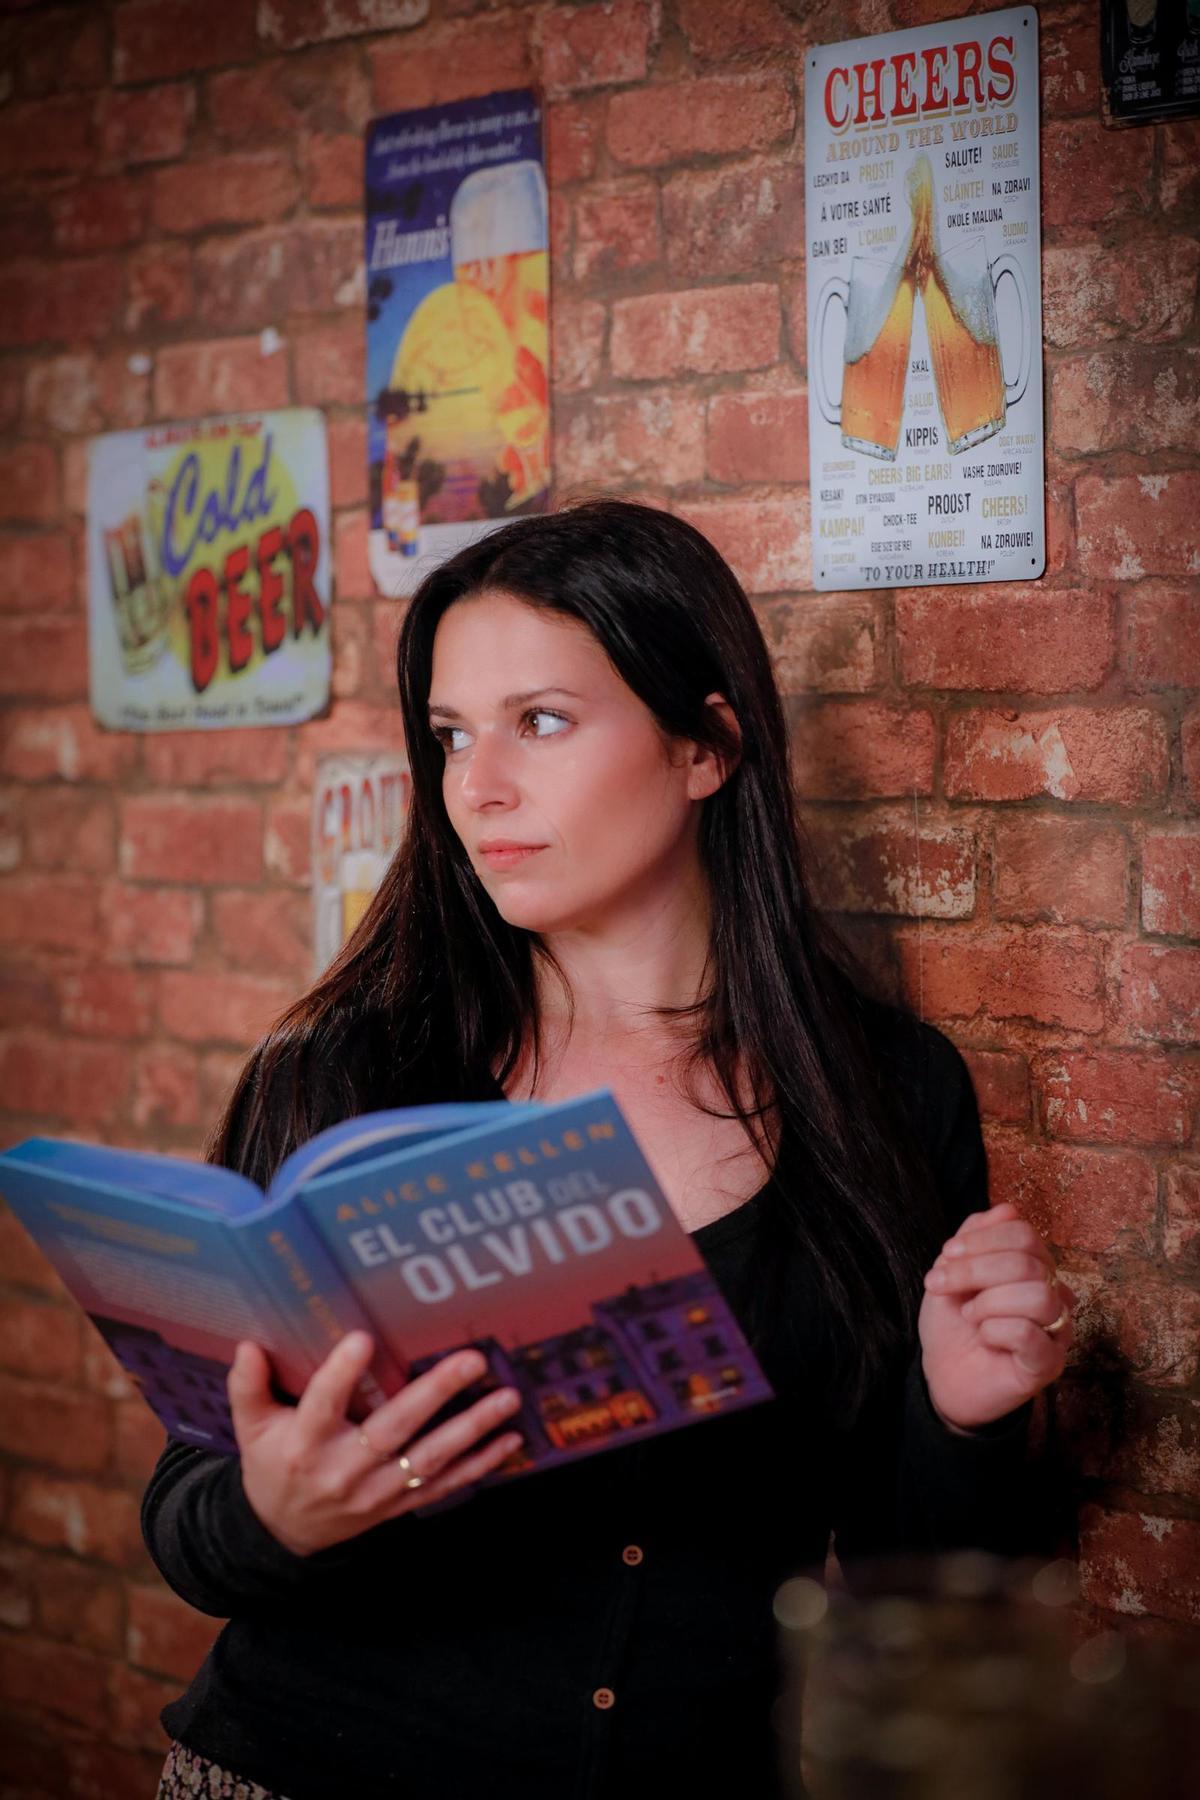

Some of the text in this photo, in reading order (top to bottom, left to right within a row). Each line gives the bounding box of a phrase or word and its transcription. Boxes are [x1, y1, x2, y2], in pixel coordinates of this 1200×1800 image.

[824, 35, 1017, 132] CHEERS
[826, 112, 1018, 163] AROUND THE WORLD
[945, 147, 982, 168] SALUTE!
[859, 160, 894, 183] PROST!
[992, 177, 1031, 196] NA ZDRAVI
[830, 201, 859, 221] VOTRE
[863, 192, 891, 216] SANTÉ
[947, 208, 1003, 228] OKOLE MALUNA
[813, 240, 830, 257] GAN
[905, 427, 939, 448] KIPPIS
[868, 465, 902, 486] CHEERS
[906, 464, 921, 482] BIG
[925, 462, 952, 481] EARS!
[963, 465, 984, 479] VASHE
[162, 433, 277, 577] Cold
[928, 493, 971, 515] PROUST
[982, 494, 1028, 518] CHEERS!
[981, 531, 1034, 549] NA ZDROWIE!
[884, 563, 923, 581] YOUR
[928, 560, 995, 579] HEALTH!"
[186, 508, 324, 694] BEER
[336, 1173, 448, 1222] ALICE
[349, 1169, 609, 1268] EL CLUB DEL
[401, 1187, 663, 1304] OLVIDO
